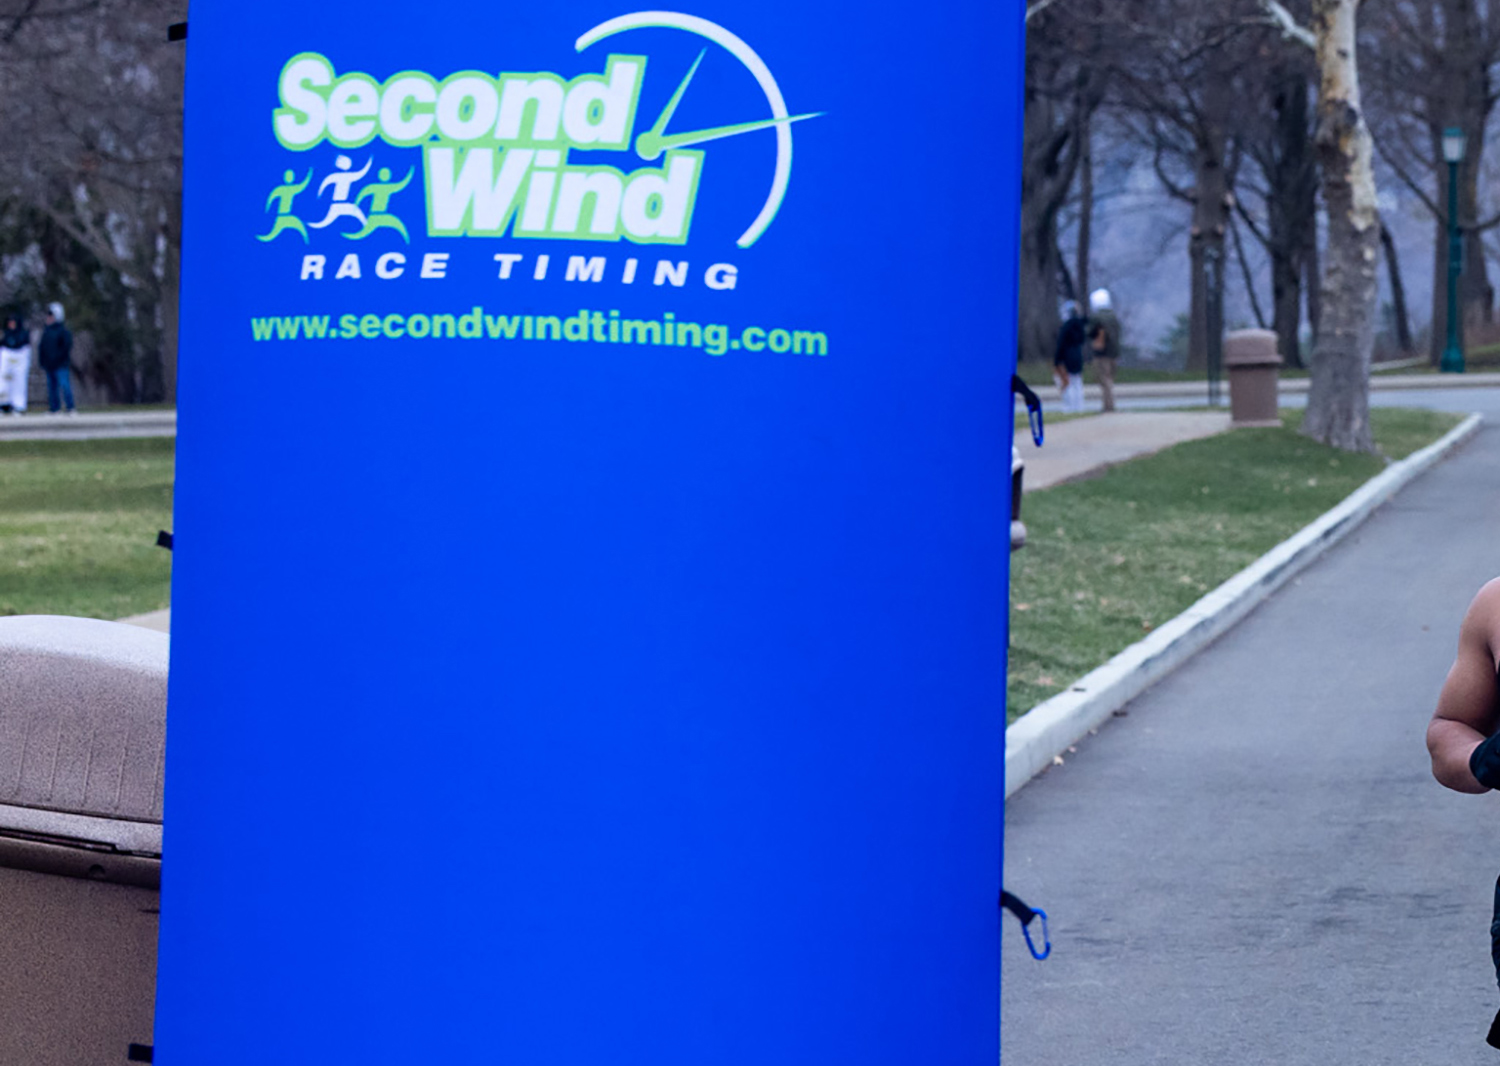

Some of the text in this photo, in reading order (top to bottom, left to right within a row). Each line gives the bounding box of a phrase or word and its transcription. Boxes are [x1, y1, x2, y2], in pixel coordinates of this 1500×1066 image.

[274, 53, 647, 150] Second
[424, 146, 704, 244] Wind
[300, 252, 740, 290] RACE TIMING
[251, 306, 828, 356] www.secondwindtiming.com
